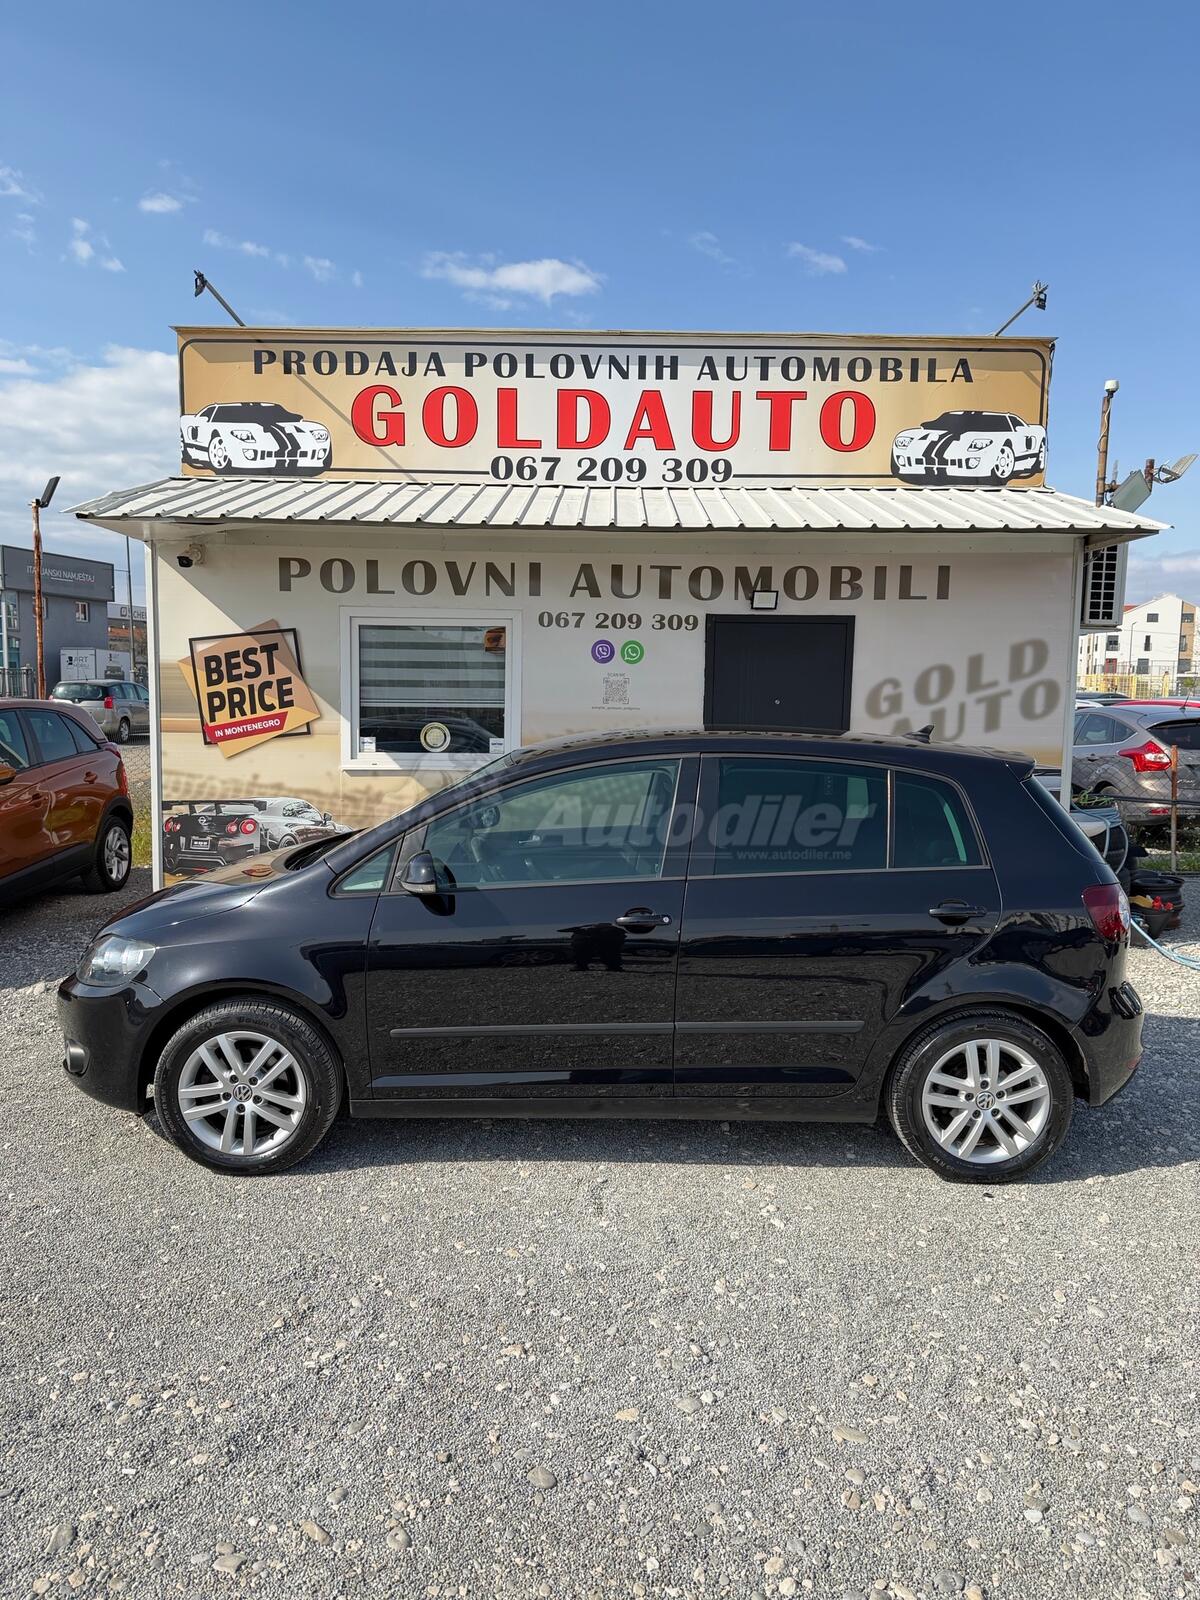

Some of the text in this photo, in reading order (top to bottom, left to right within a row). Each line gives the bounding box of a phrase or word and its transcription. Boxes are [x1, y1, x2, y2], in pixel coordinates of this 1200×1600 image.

[253, 349, 974, 383] PRODAJA POLOVNIH AUTOMOBILA
[350, 384, 877, 453] GOLDAUTO
[490, 455, 733, 483] 067 209 309
[278, 557, 951, 600] POLOVNI AUTOMOBILI
[538, 611, 699, 631] 067 209 309
[203, 642, 279, 687] BEST
[865, 638, 1050, 720] GOLD
[206, 676, 295, 723] PRICE
[214, 718, 281, 737] IN MONTENEGRO
